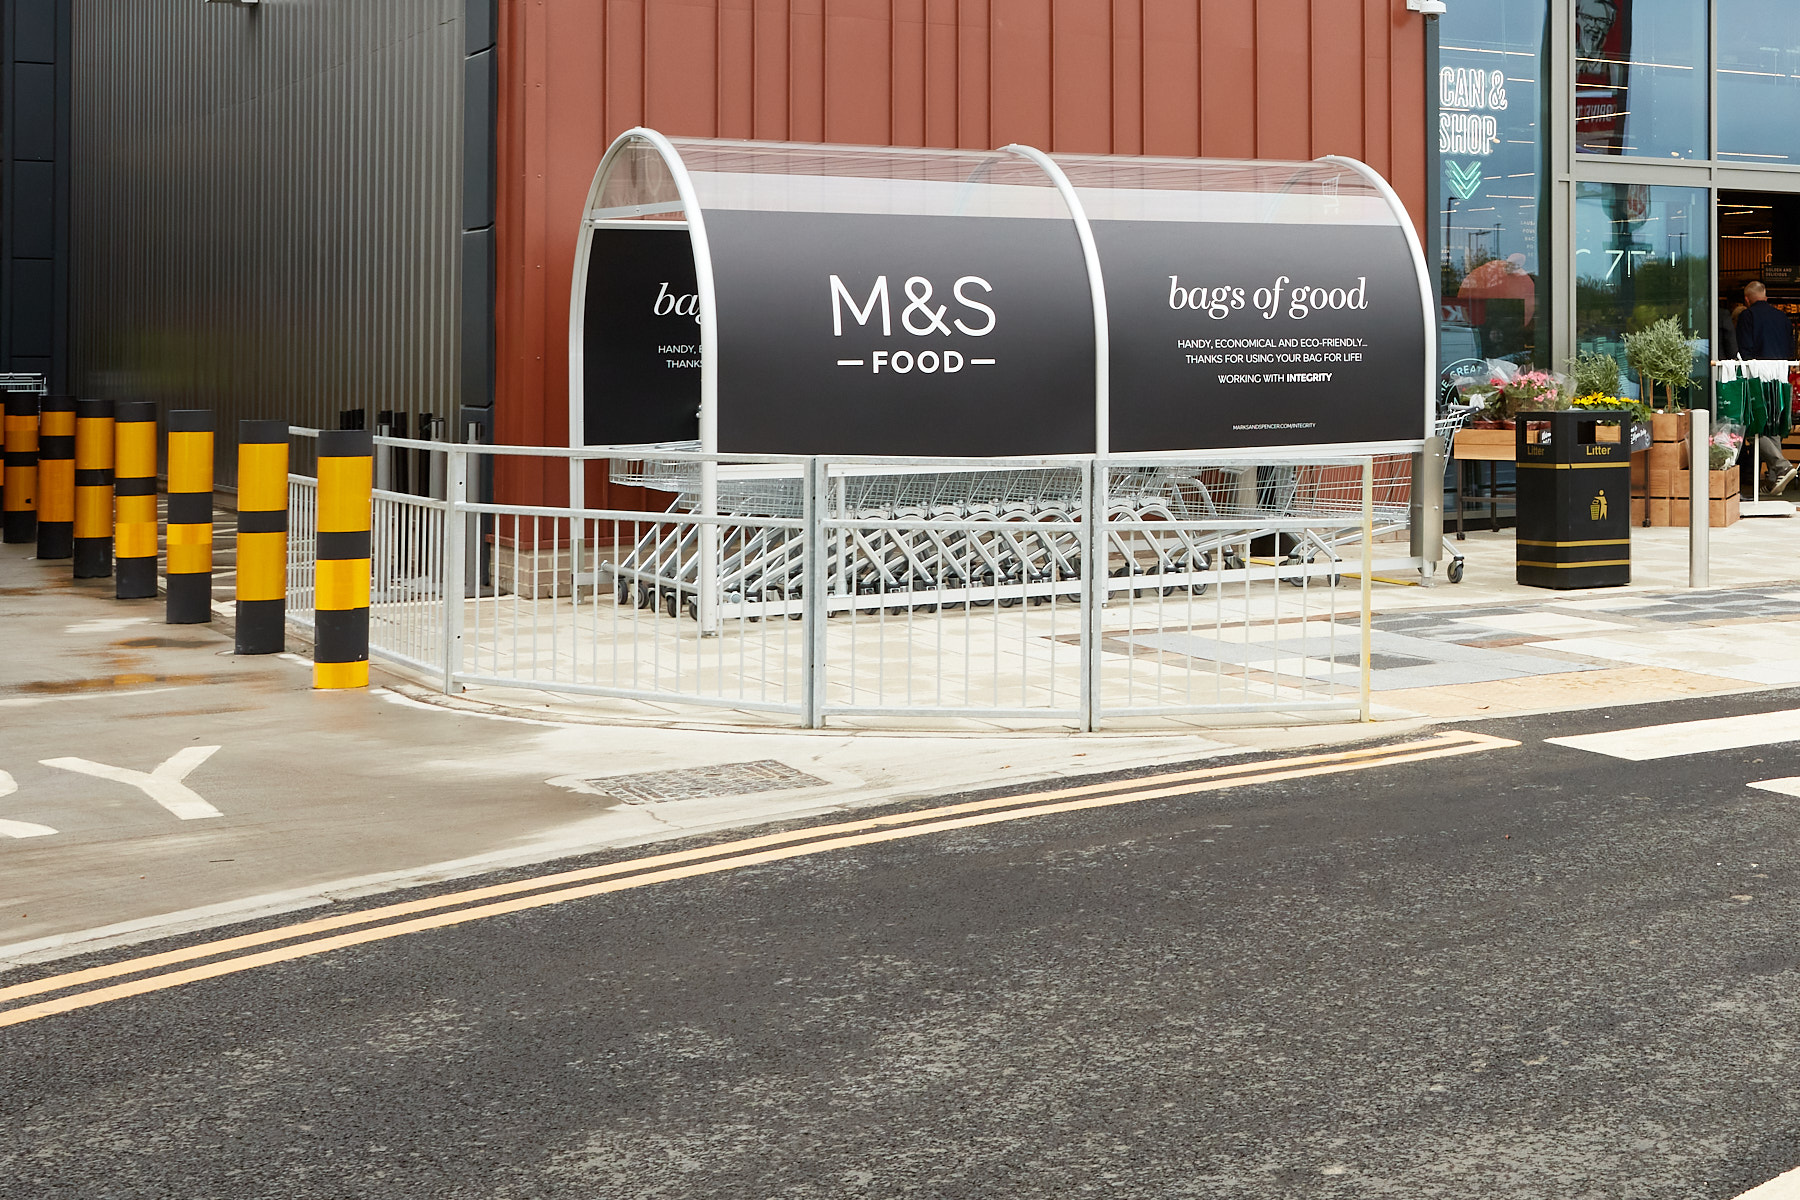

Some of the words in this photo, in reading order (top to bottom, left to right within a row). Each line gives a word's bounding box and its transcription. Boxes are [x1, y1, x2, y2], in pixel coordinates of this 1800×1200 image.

[1439, 112, 1497, 155] SHOP
[1169, 275, 1246, 320] bags
[1252, 275, 1290, 320] of
[1288, 276, 1369, 320] good
[829, 274, 996, 337] M&S
[658, 344, 697, 354] HANDY,
[1177, 339, 1214, 350] HANDY,
[1215, 338, 1277, 349] ECONOMICAL
[1278, 338, 1299, 348] AND
[873, 350, 964, 374] FOOD
[1186, 354, 1223, 364] THANKS
[1224, 354, 1244, 364] FOR
[1245, 354, 1274, 363] USING
[1275, 353, 1302, 363] YOUR
[1303, 353, 1323, 362] BAG
[1324, 353, 1342, 362] FOR
[1343, 352, 1363, 362] LIFE!
[1217, 374, 1262, 384] WORKING
[1263, 373, 1285, 383] WITH
[1286, 372, 1333, 383] INTEGRITY
[1527, 446, 1545, 456] Litter
[1586, 445, 1612, 456] Litter
